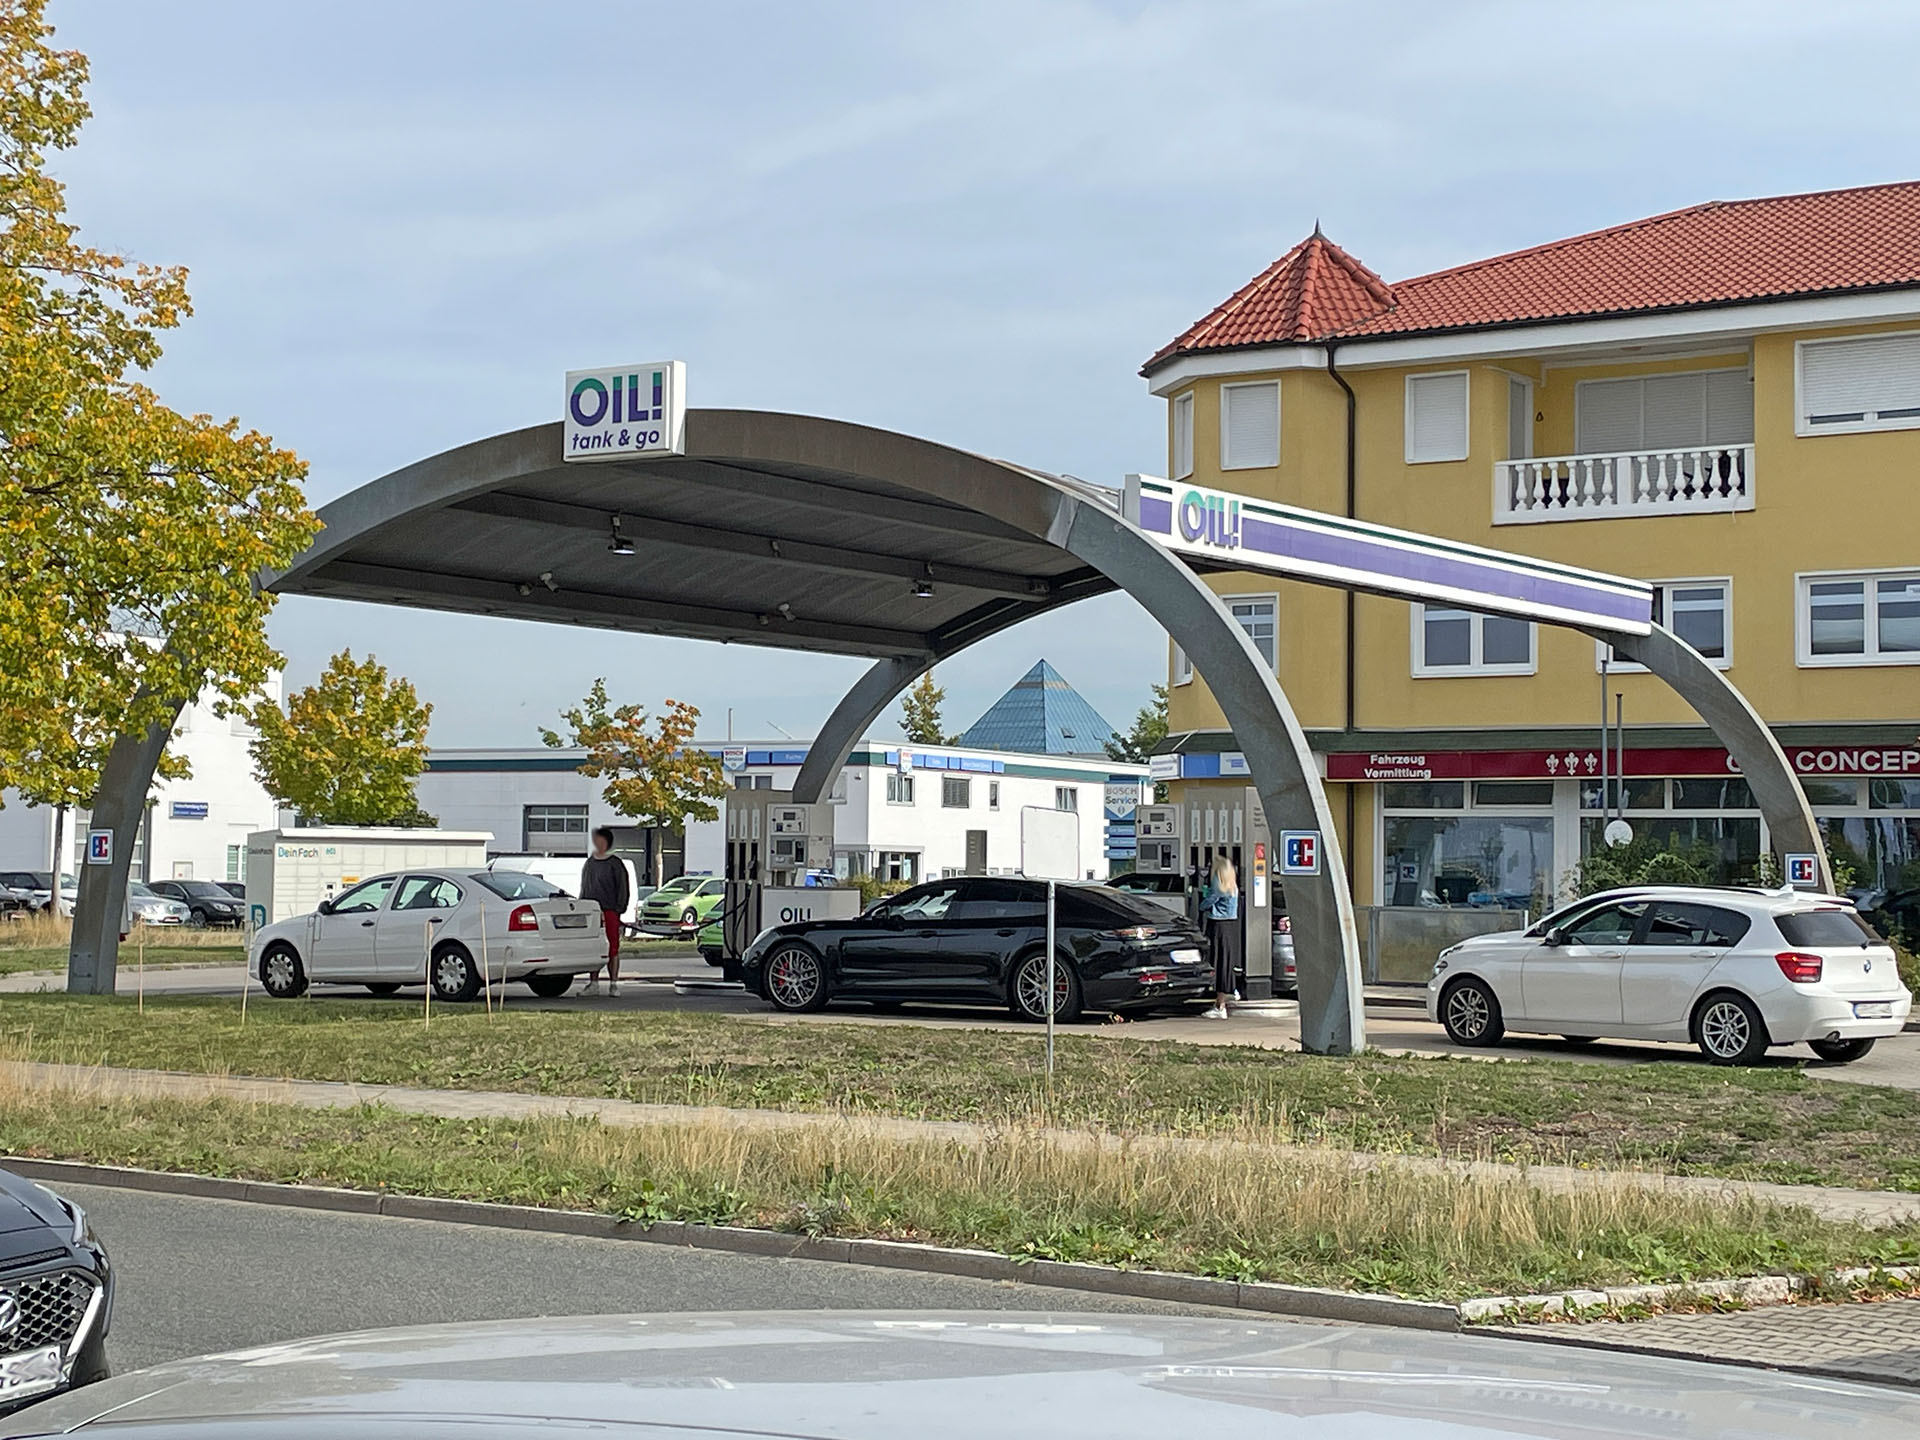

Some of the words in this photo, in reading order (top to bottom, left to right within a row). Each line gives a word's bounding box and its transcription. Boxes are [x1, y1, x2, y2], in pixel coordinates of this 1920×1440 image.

[570, 371, 663, 427] OIL!
[572, 430, 614, 451] tank
[618, 429, 631, 446] &
[635, 430, 660, 450] go
[1178, 490, 1239, 549] OIL!
[1370, 754, 1426, 766] Fahrzeug
[1364, 768, 1432, 780] Vermittlung
[1106, 787, 1138, 795] BOSCH
[1166, 822, 1173, 833] 3
